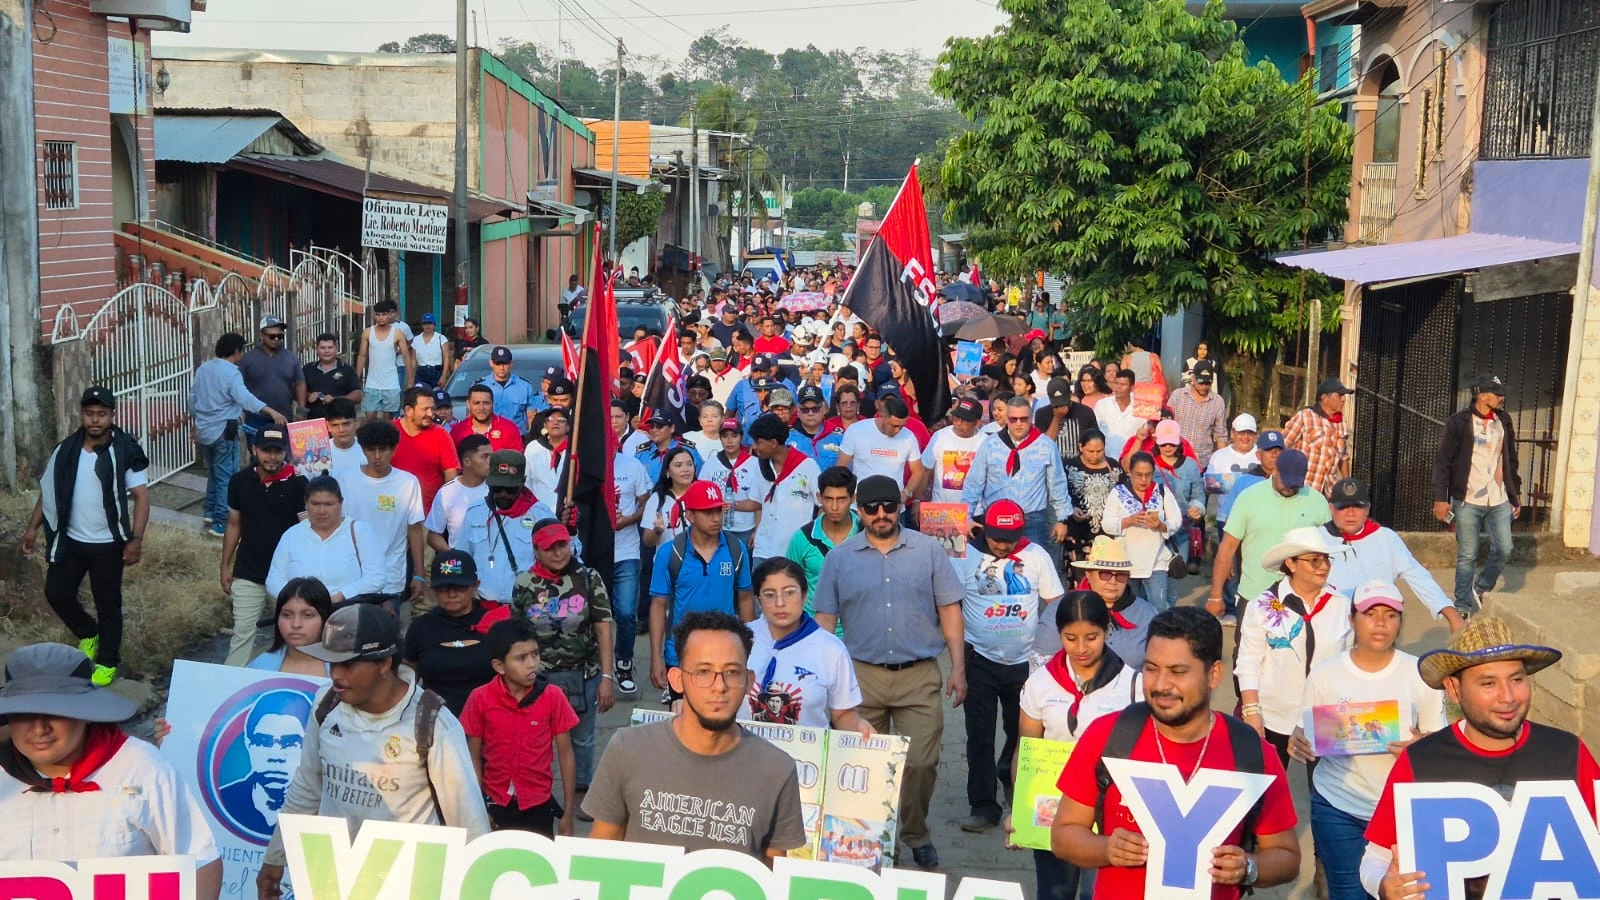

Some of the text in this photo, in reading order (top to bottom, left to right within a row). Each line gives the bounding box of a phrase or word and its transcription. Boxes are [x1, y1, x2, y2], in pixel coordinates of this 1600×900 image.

[365, 200, 447, 218] Oficina de Leyes
[364, 213, 379, 230] Lic.
[380, 215, 411, 233] Roberto
[365, 230, 401, 240] Abogado
[410, 234, 445, 244] Notario
[984, 603, 1022, 618] 4519
[326, 781, 384, 808] FLY BETTER
[640, 789, 756, 827] AMERICAN
[640, 809, 748, 846] EAGLE USA
[1129, 776, 1245, 890] Y
[299, 832, 1012, 900] VICT
